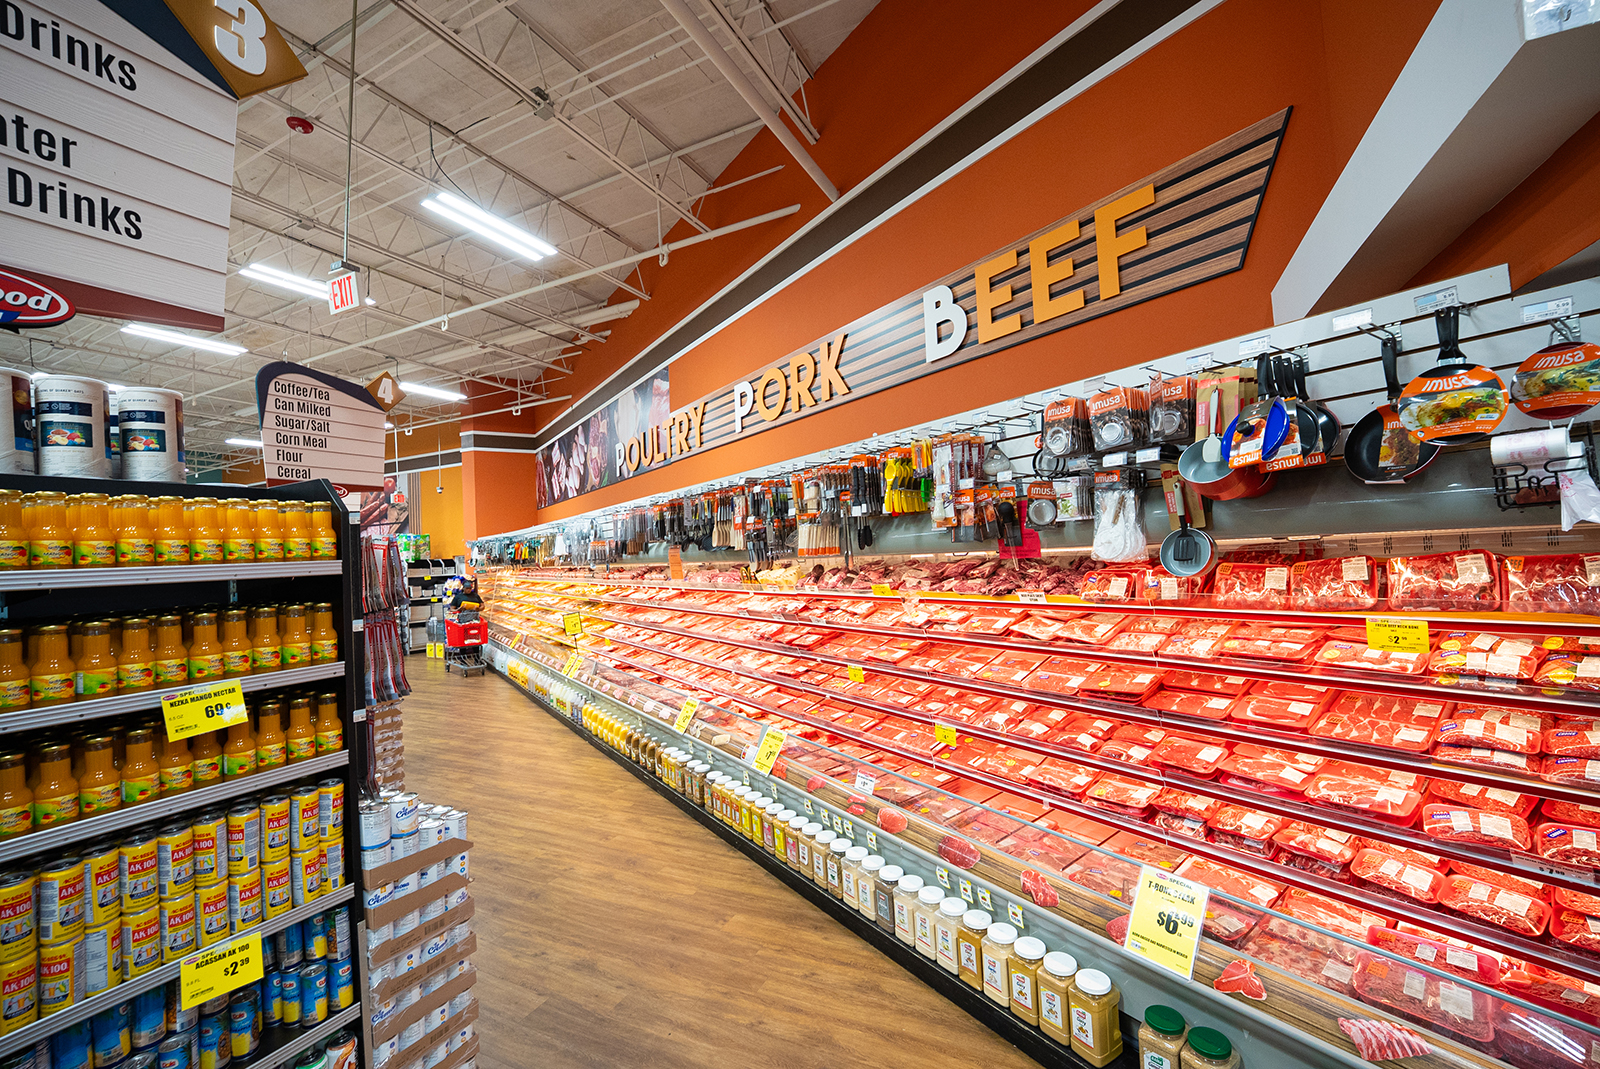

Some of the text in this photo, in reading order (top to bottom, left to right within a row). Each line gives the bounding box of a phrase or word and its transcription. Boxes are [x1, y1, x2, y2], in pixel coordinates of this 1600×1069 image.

[0, 1, 137, 92] Drinks
[214, 0, 266, 75] 3
[8, 167, 143, 240] Drinks
[922, 183, 1156, 363] BEEF
[331, 275, 354, 310] EXIT
[1533, 351, 1585, 368] imusa
[274, 380, 330, 400] Coffee/Tea
[378, 378, 394, 404] 4
[734, 333, 850, 434] PORK
[1422, 375, 1472, 392] imusa
[274, 398, 331, 417] Can Milked
[1047, 405, 1072, 418] imusa
[1092, 395, 1120, 410] imusa
[275, 415, 330, 434] Sugar/Salt
[276, 432, 328, 449] Corn Meal
[614, 402, 706, 477] POULTRY
[276, 449, 303, 463] Flour
[277, 466, 311, 480] Cereal
[1031, 486, 1056, 495] imusa
[170, 687, 236, 708] NEZKA MANGO NECTAR
[1169, 878, 1192, 890] SPECIAL
[195, 943, 249, 969] ACASSAN AK 100
